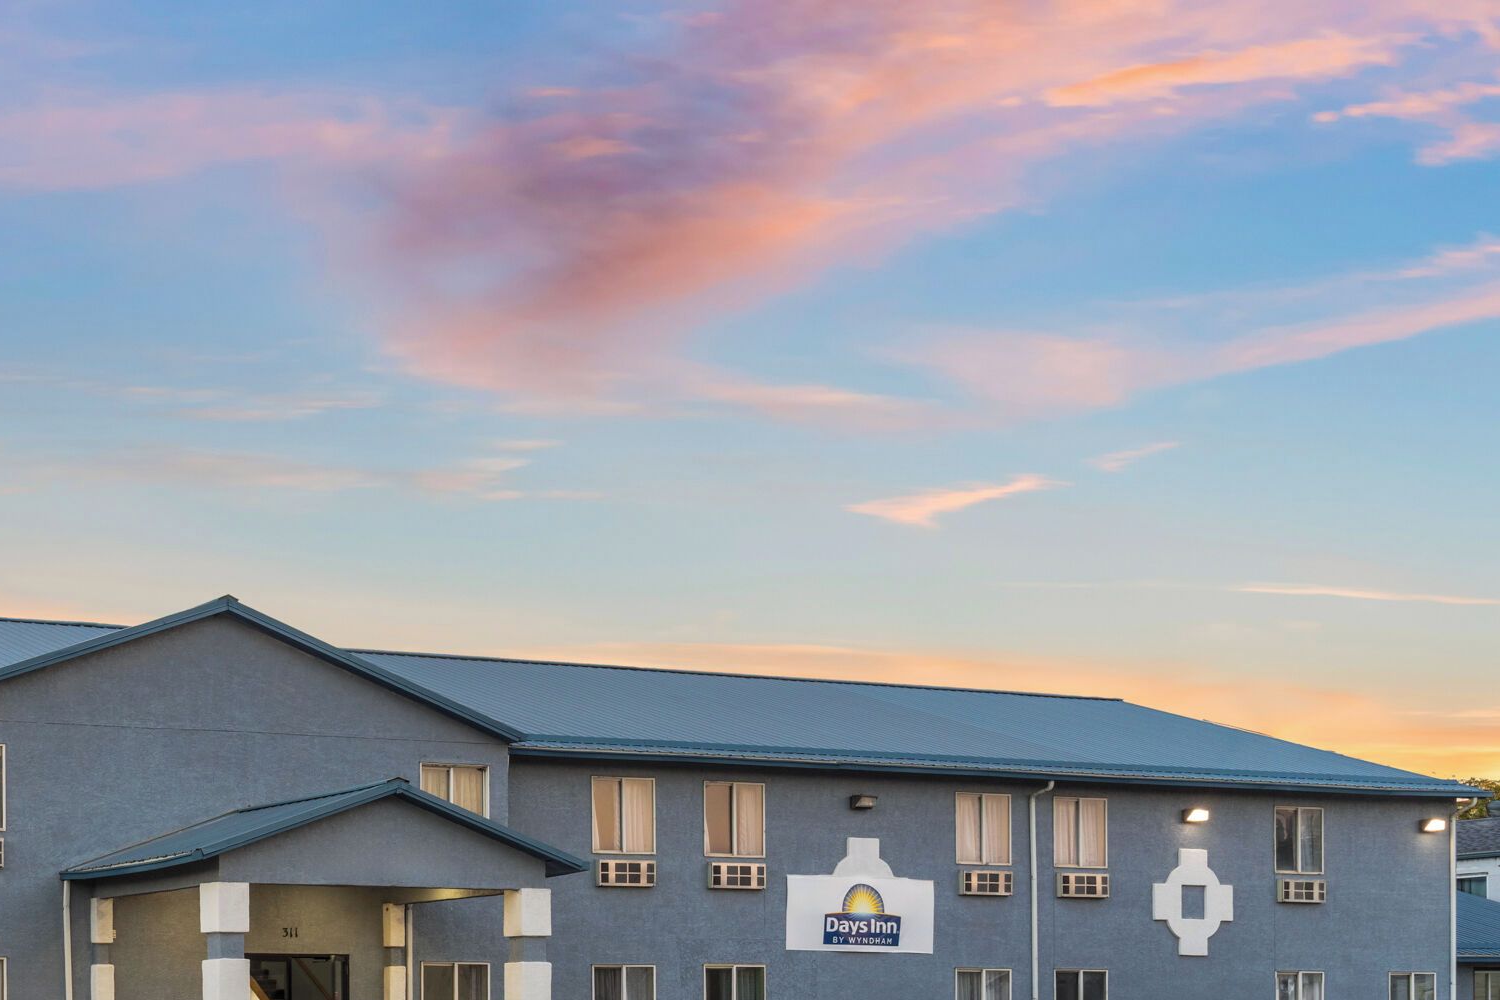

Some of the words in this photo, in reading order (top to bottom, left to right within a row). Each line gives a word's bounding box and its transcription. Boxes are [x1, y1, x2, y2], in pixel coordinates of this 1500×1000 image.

[826, 917, 868, 935] Days
[870, 918, 897, 934] Inn
[282, 927, 298, 938] 311
[832, 936, 844, 944] BY
[848, 936, 893, 945] WYNDHAM
